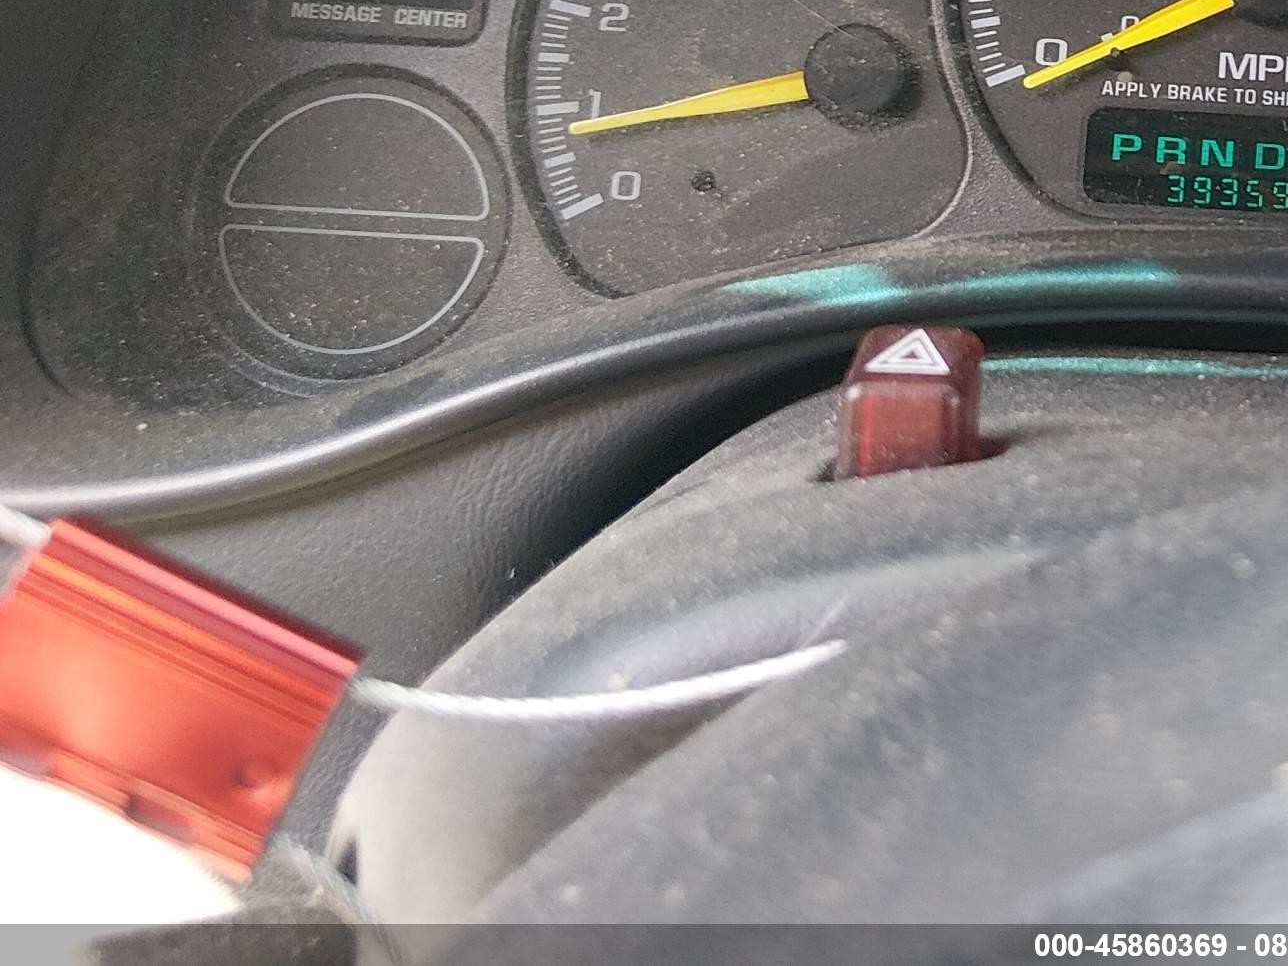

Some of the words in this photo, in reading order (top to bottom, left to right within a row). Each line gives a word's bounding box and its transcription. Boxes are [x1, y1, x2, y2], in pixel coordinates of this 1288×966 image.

[291, 2, 382, 23] MESSAGE
[395, 9, 468, 28] CENTER
[600, 3, 629, 31] 2
[1035, 38, 1068, 66] 0
[1101, 80, 1161, 99] APPLY
[1167, 84, 1227, 103] BRAKE
[1234, 88, 1257, 105] TO
[1112, 134, 1142, 160] P
[1156, 137, 1187, 164] R
[1201, 139, 1233, 167] N
[1254, 143, 1285, 170] D
[610, 172, 641, 200] 0
